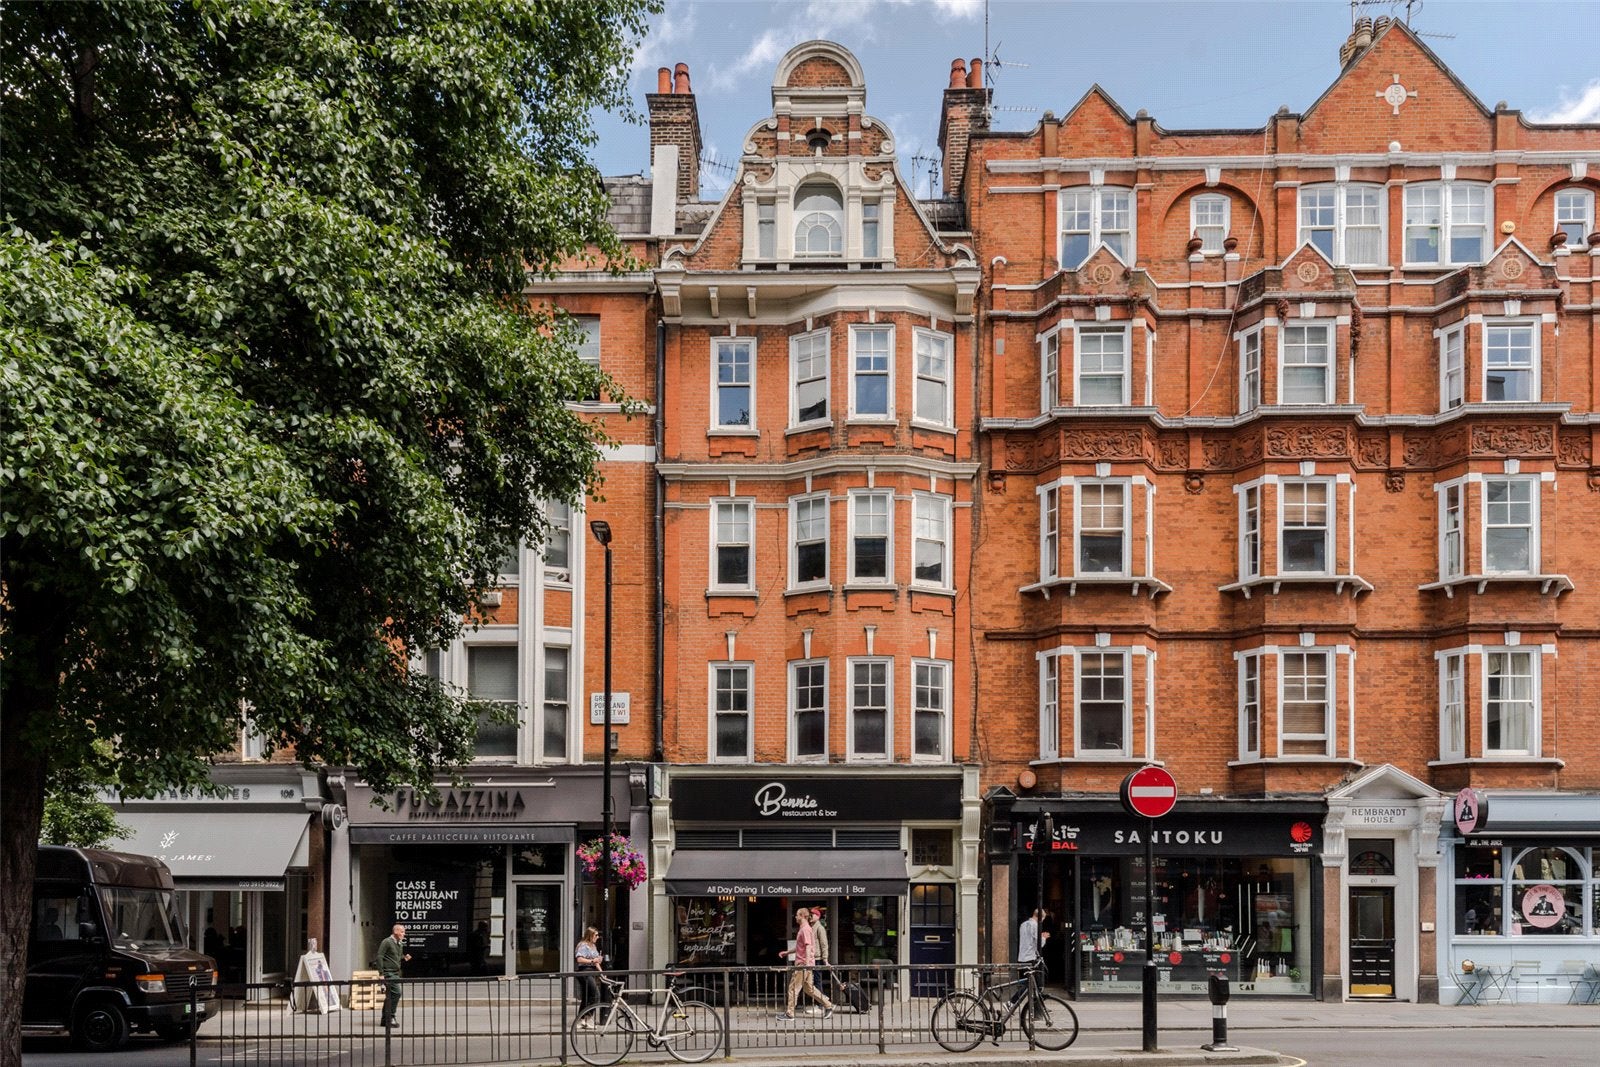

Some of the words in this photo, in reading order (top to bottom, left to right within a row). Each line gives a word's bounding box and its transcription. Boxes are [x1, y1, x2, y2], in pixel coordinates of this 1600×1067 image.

[754, 782, 818, 816] Bennie
[1351, 808, 1407, 816] REMBRANDT
[389, 833, 417, 841] CAFFE
[422, 833, 479, 841] PASTICCERIA
[483, 833, 536, 841] RISTORANTE
[395, 881, 427, 890] CLASS
[429, 881, 436, 890] E
[707, 885, 716, 893] All
[717, 885, 732, 894] Day
[734, 885, 758, 894] Dining
[768, 885, 792, 893] Coffee
[802, 885, 842, 893] Restaurant
[852, 885, 866, 893] Bar
[395, 891, 459, 900] RESTAURANT
[395, 901, 443, 910] PREMISES
[686, 899, 706, 920] Love
[395, 911, 409, 920] TO
[412, 911, 428, 920] LET
